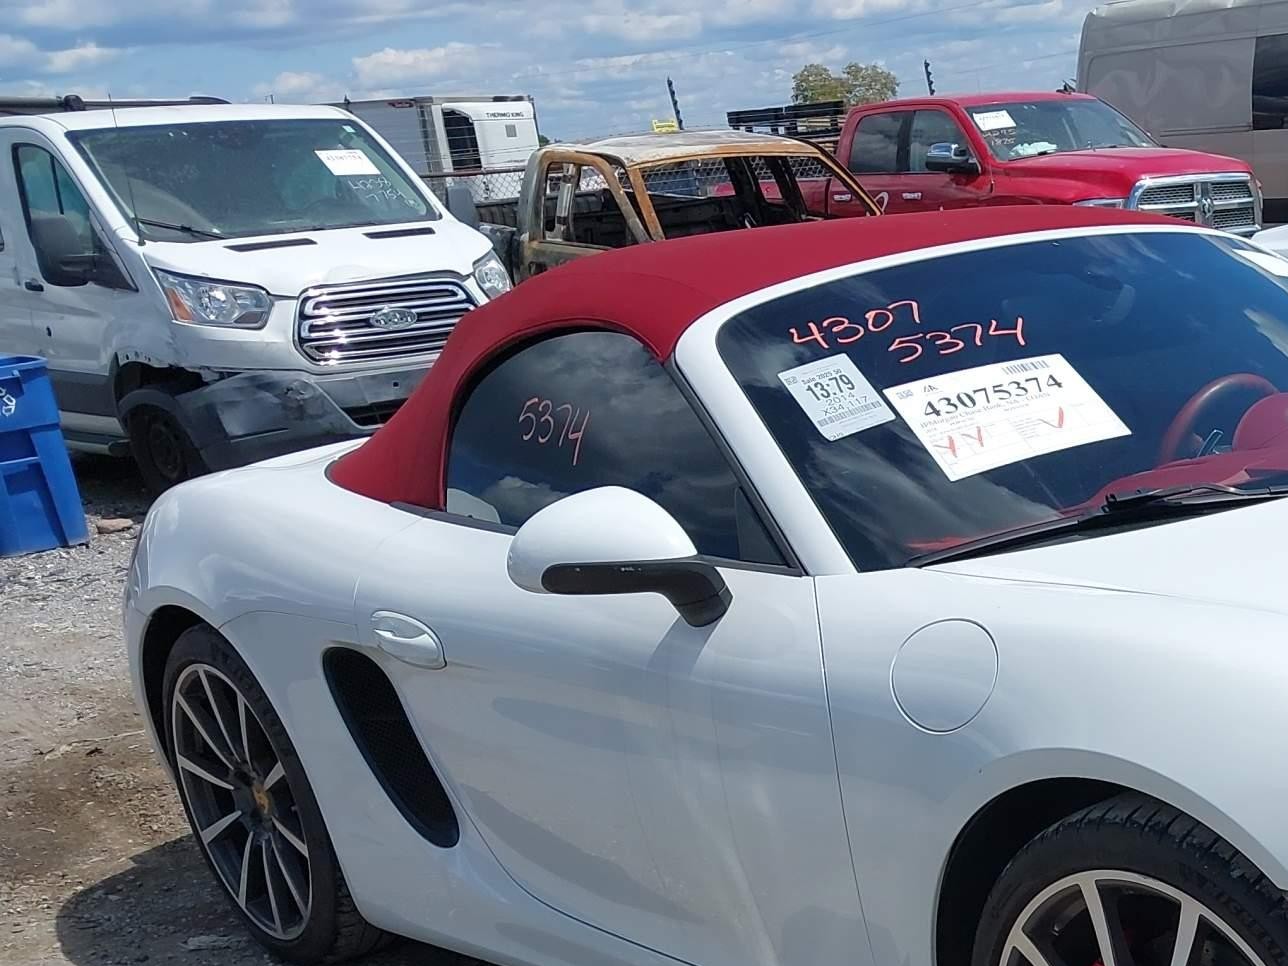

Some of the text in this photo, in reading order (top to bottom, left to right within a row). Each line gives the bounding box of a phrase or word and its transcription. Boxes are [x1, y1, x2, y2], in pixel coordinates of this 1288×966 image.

[788, 299, 922, 349] 4307
[887, 316, 1027, 364] 5374
[806, 374, 856, 402] 13:79
[825, 392, 856, 407] 2014
[924, 373, 1064, 418] 43075374
[518, 397, 590, 467] 5374
